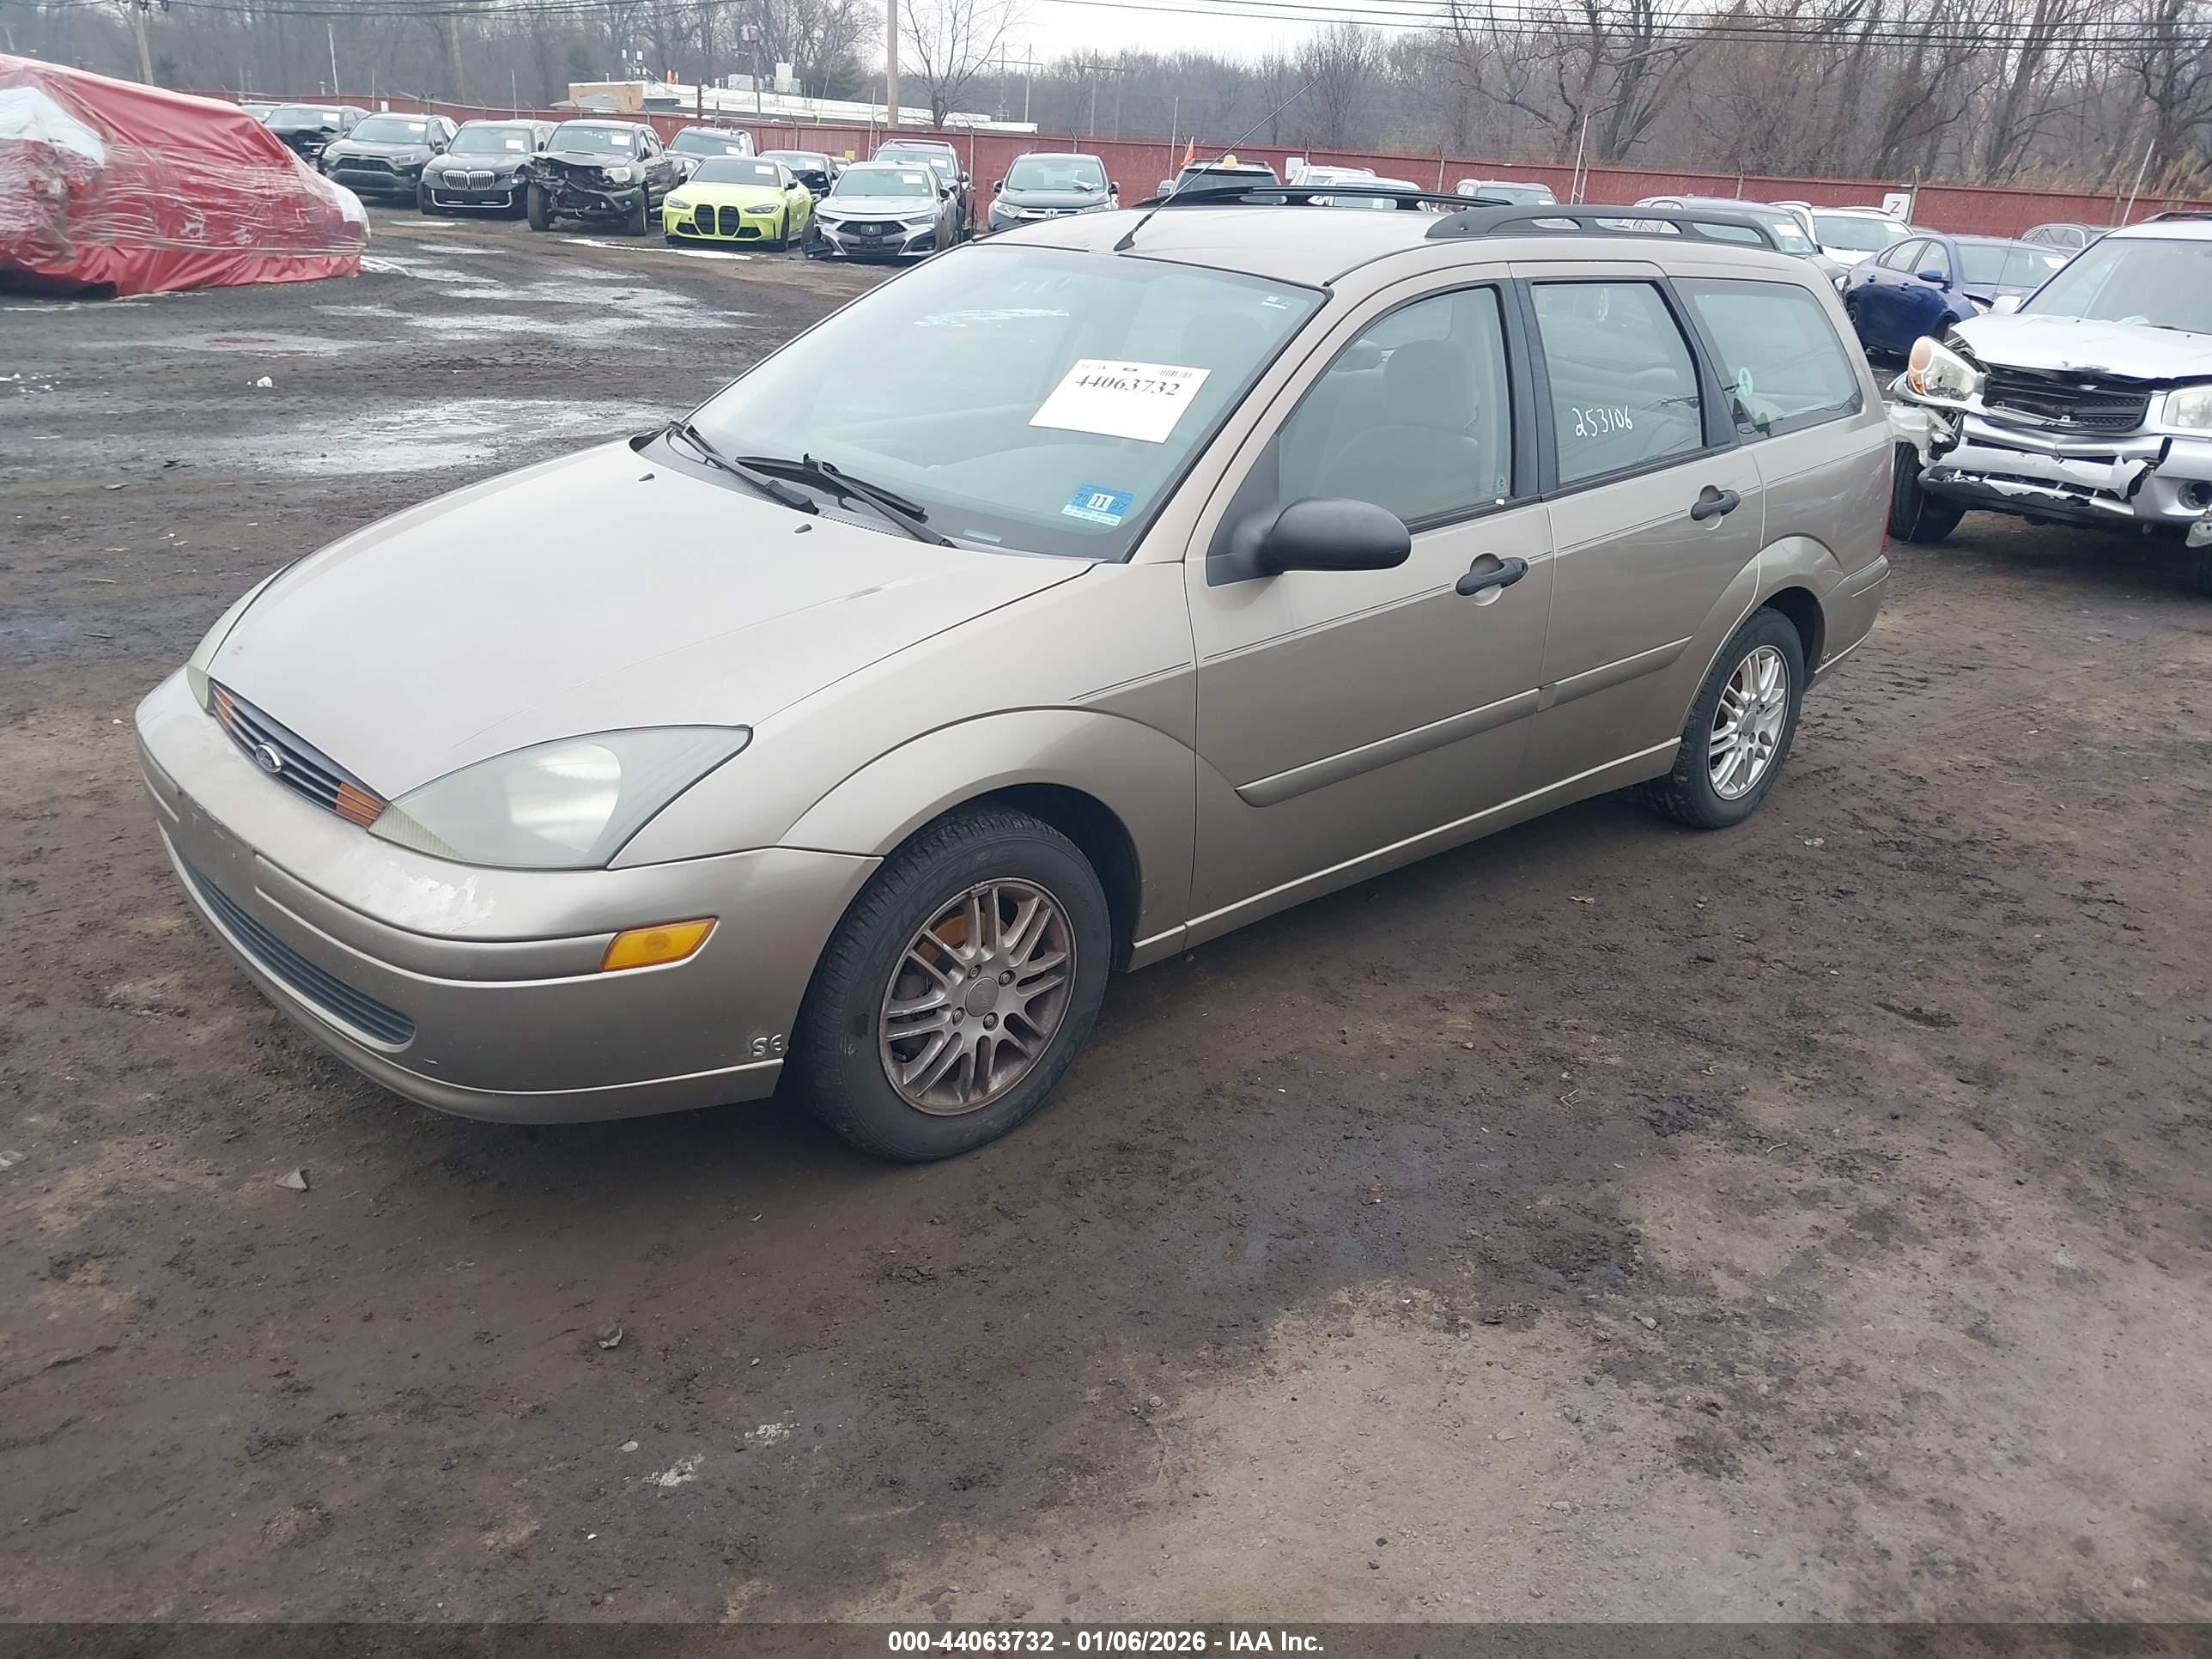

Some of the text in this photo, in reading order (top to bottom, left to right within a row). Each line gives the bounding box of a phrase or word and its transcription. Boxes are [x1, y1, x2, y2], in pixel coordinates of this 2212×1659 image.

[1889, 200, 1901, 214] Z
[1075, 374, 1182, 396] 44063732
[1571, 404, 1633, 437] 253106
[1090, 495, 1109, 508] 11
